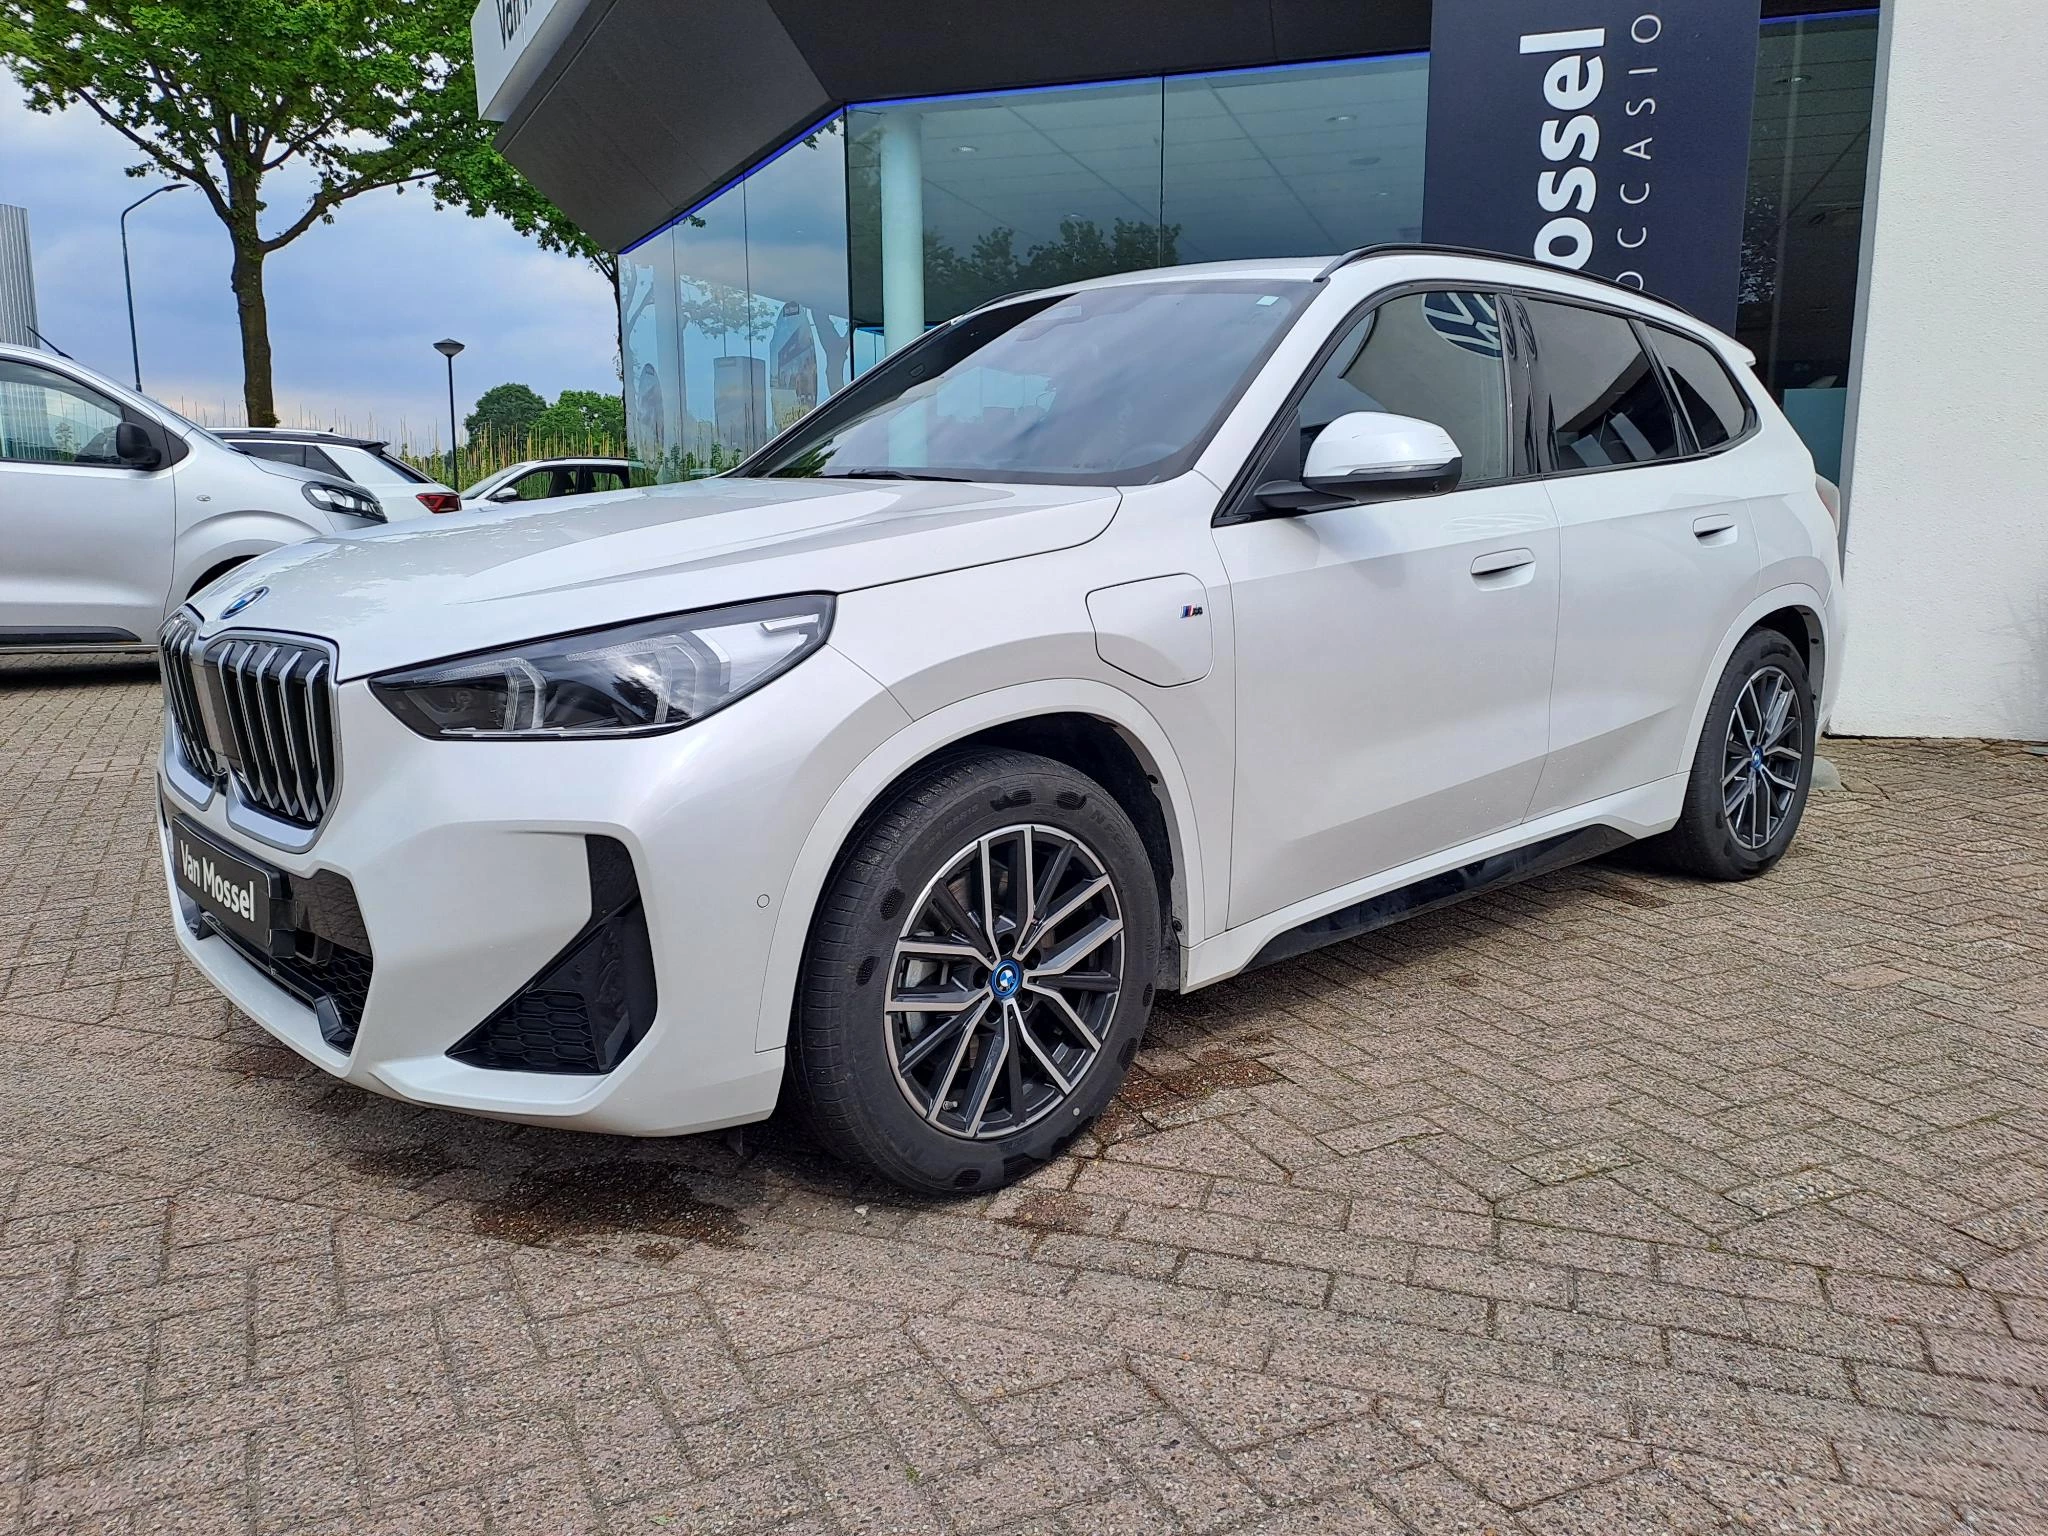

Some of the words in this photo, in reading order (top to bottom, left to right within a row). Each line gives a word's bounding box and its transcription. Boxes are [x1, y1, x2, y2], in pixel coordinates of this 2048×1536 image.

[1519, 27, 1605, 270] ossel
[179, 839, 201, 888] Van
[202, 856, 255, 922] Mossel
